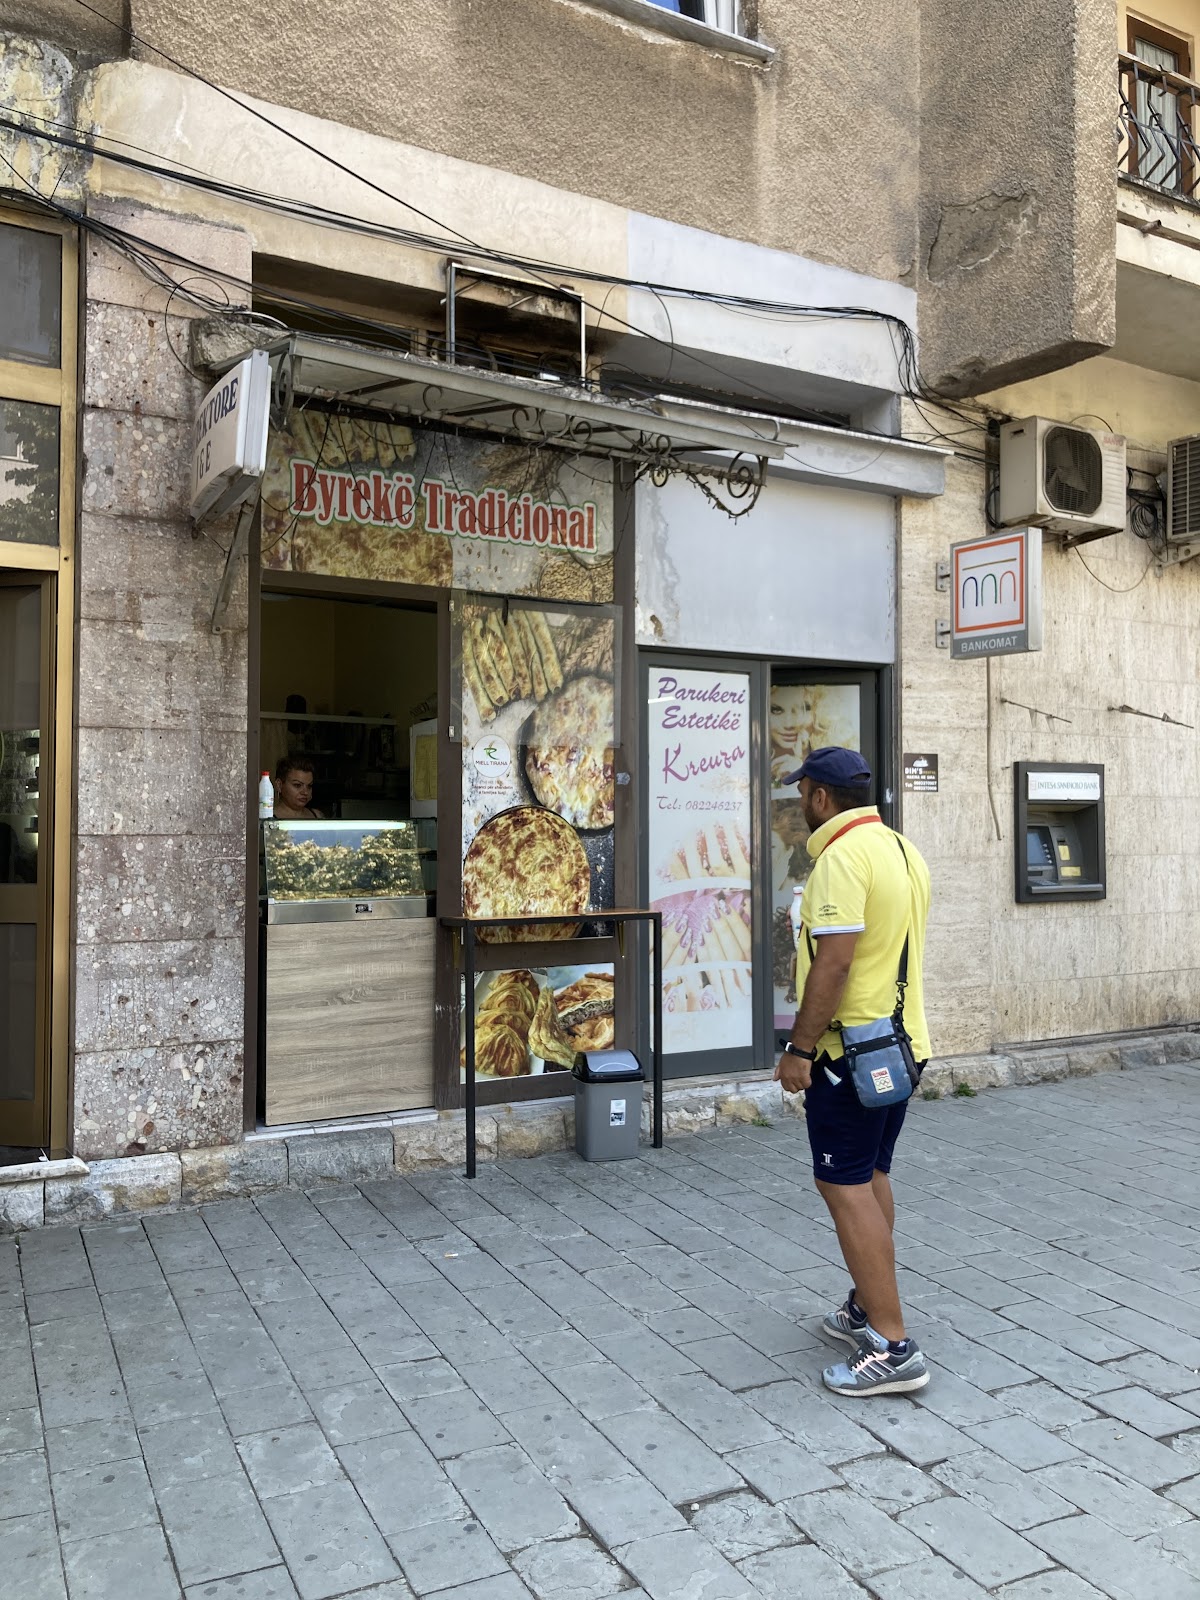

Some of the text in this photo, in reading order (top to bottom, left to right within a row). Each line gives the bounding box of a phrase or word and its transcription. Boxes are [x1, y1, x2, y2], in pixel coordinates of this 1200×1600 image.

[292, 462, 596, 550] Byrekë Tradicional
[961, 636, 1018, 653] BANKOMAT
[658, 676, 745, 704] Parukeri
[661, 705, 742, 731] Estetikë
[662, 743, 745, 784] Kreuza
[1083, 781, 1098, 790] BANK
[656, 795, 681, 810] Tel:
